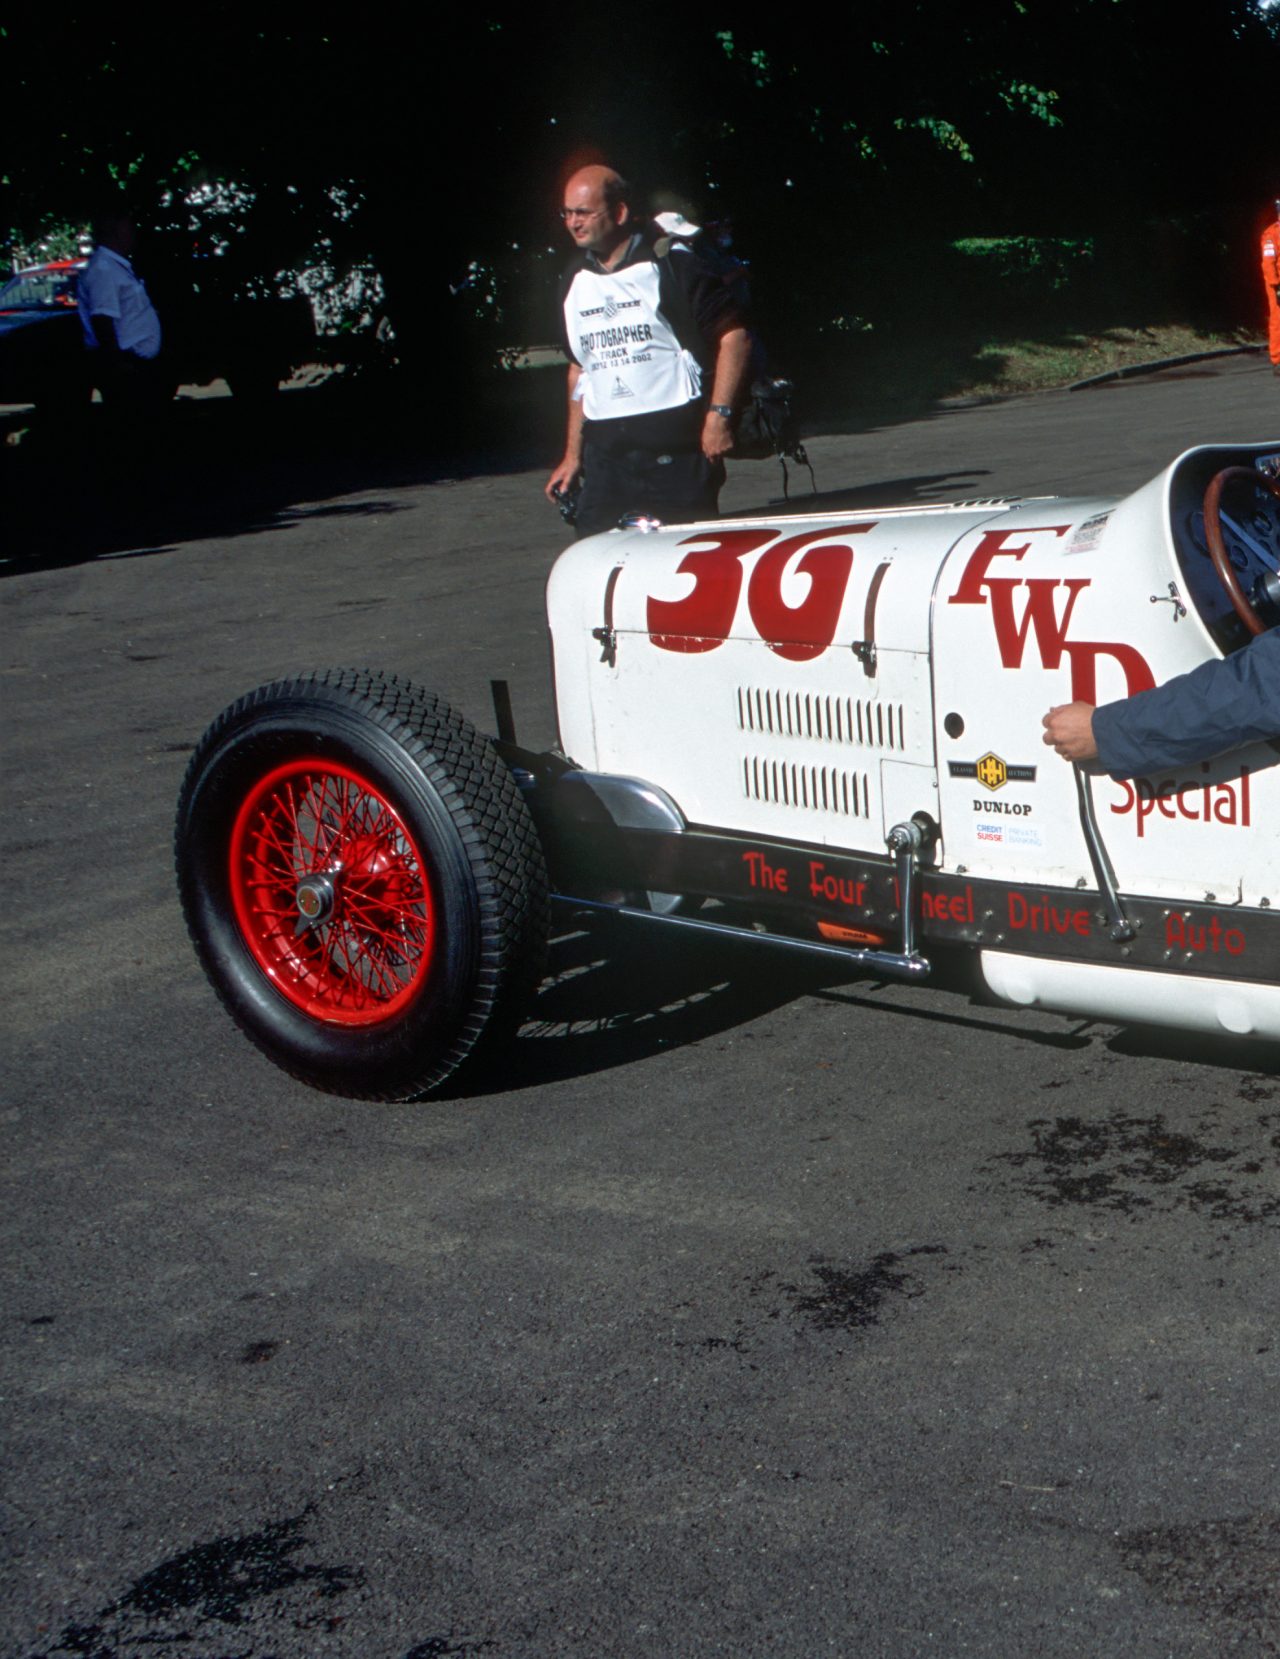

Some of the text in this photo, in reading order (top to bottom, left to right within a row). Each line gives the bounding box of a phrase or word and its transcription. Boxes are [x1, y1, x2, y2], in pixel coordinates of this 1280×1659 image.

[580, 324, 653, 354] PHOTOGRAPHER
[600, 347, 628, 361] TRACK
[632, 353, 652, 364] 2002
[646, 521, 880, 662] 36
[973, 799, 1032, 816] DUNLOP
[1110, 761, 1250, 837] Special
[976, 824, 1003, 833] CREDIT
[976, 832, 1003, 842] SUISSE
[743, 851, 789, 892] The
[809, 861, 866, 907] Four
[894, 875, 975, 923] heel
[1007, 891, 1091, 936] Drive
[1166, 912, 1246, 955] Auto
